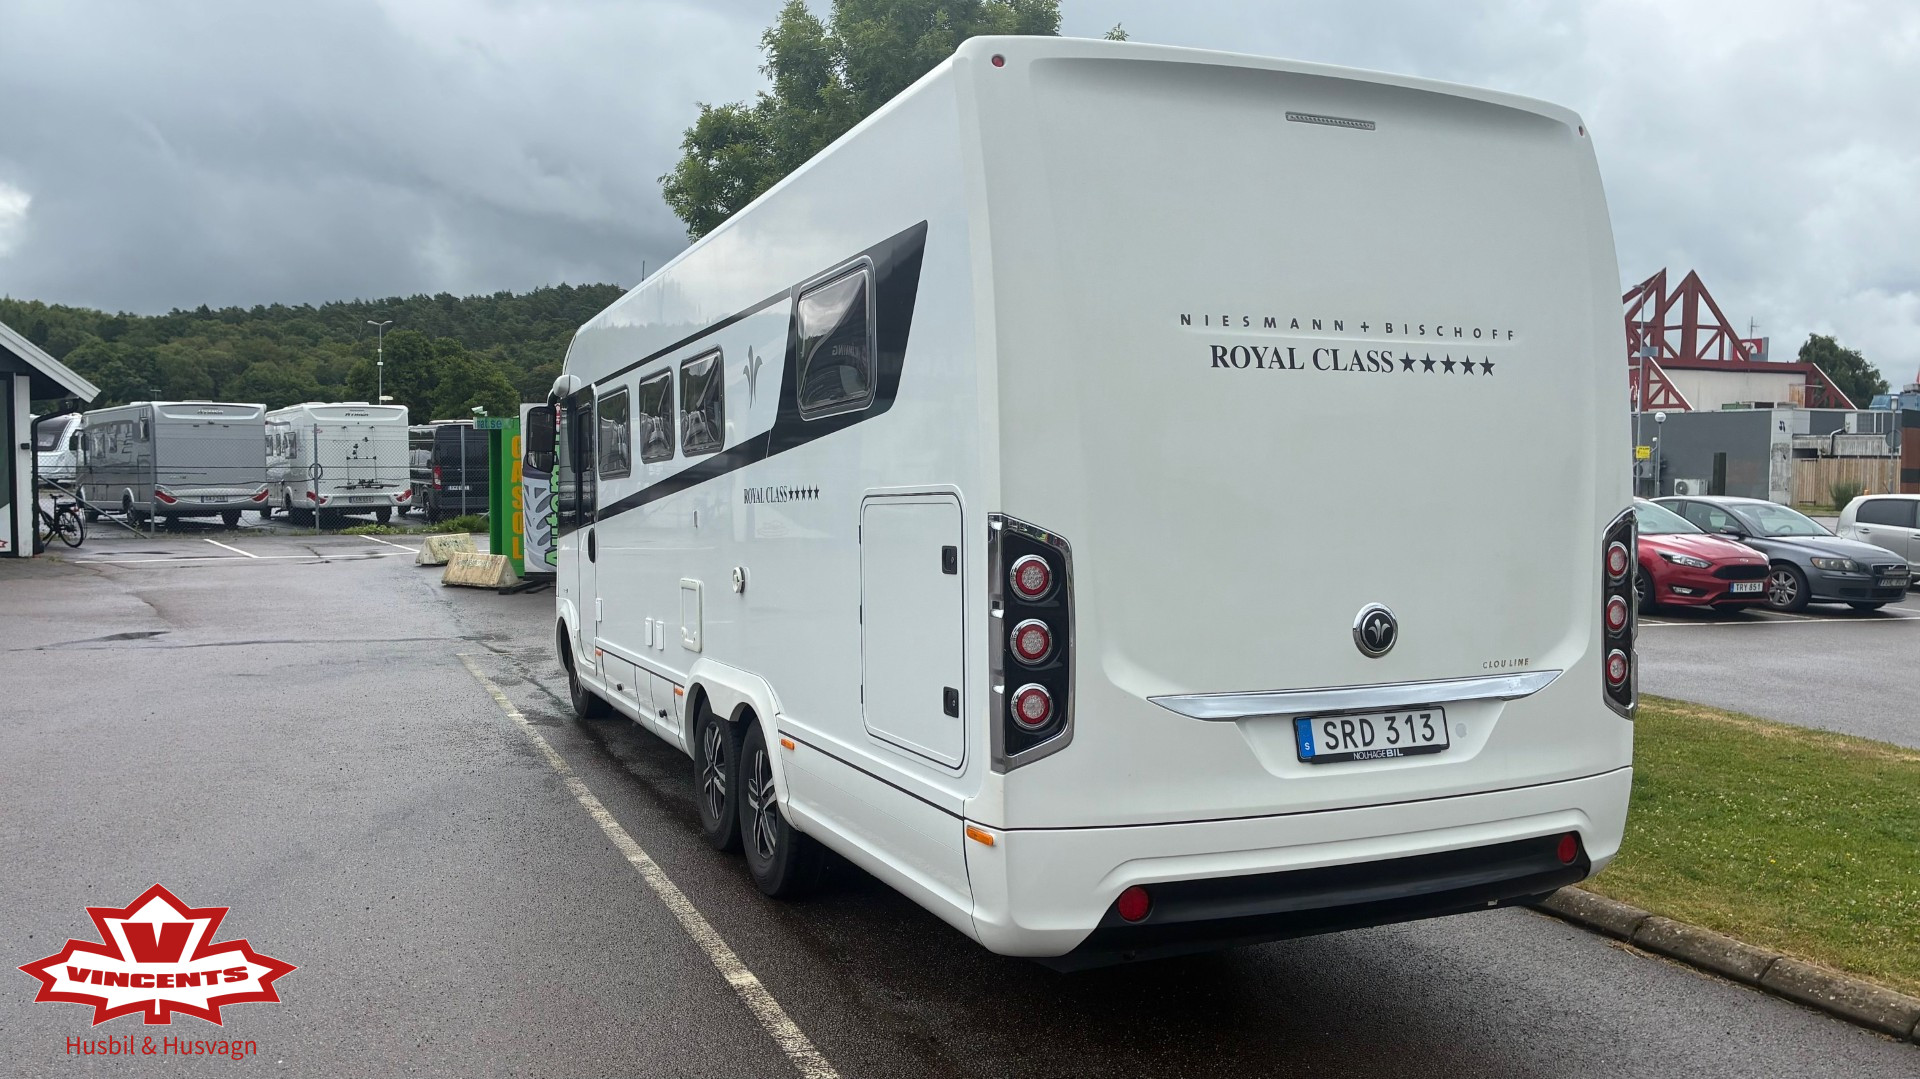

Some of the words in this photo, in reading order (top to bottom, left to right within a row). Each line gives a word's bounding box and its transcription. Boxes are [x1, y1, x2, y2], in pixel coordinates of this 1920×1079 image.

[1209, 344, 1305, 370] ROYAL
[1312, 347, 1394, 373] CLASS
[743, 487, 765, 504] ROYAL
[765, 485, 788, 503] CLASS
[1482, 660, 1507, 669] CLOU
[1509, 657, 1529, 667] LINE
[1323, 719, 1375, 750] SRD
[1384, 713, 1435, 744] 313
